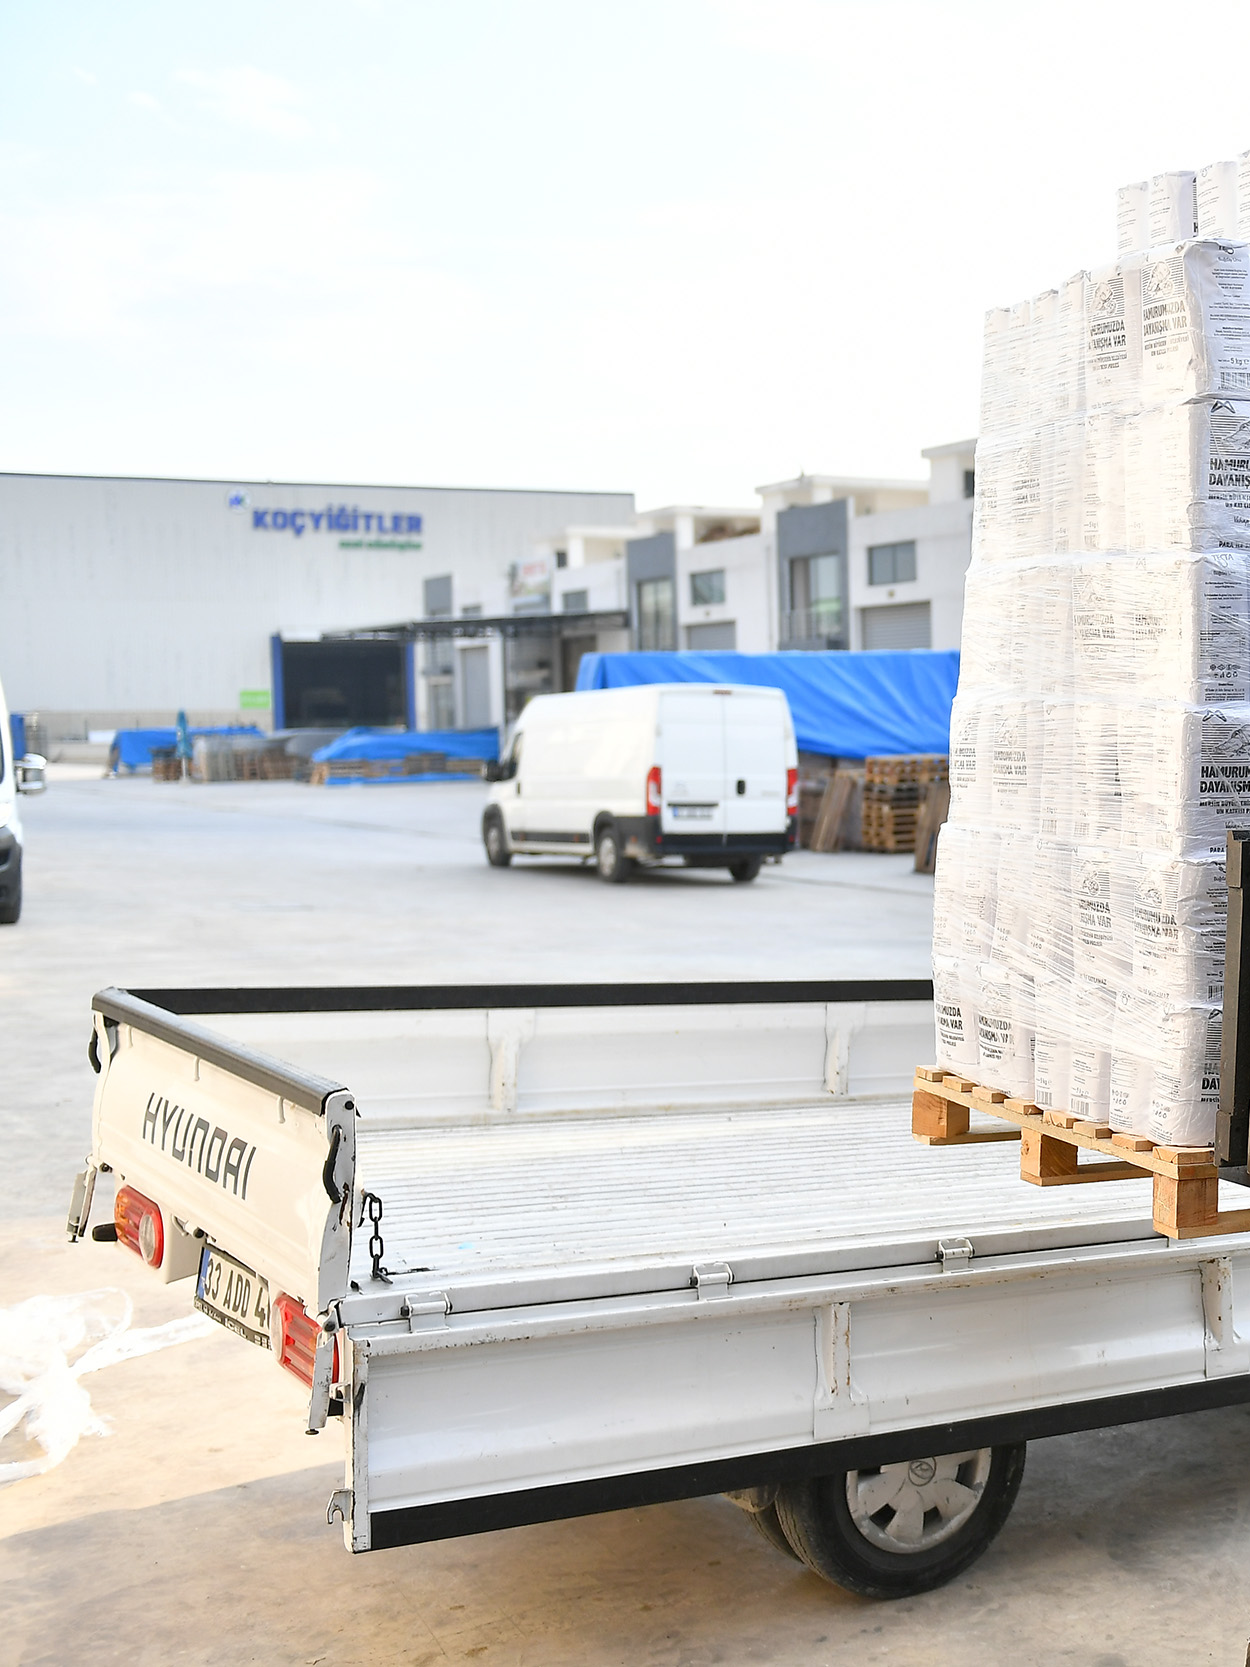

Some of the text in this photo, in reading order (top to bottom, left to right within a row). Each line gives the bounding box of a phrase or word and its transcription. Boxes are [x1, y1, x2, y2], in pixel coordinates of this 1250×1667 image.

[1172, 315, 1187, 330] VAR
[1113, 334, 1126, 347] VAR
[1235, 356, 1243, 366] kg
[253, 505, 423, 536] KOÇYİĞİTLER
[949, 1018, 963, 1030] VAR
[142, 1092, 257, 1201] HYUNDAI
[205, 1258, 222, 1300] 33
[222, 1269, 251, 1319] ADD
